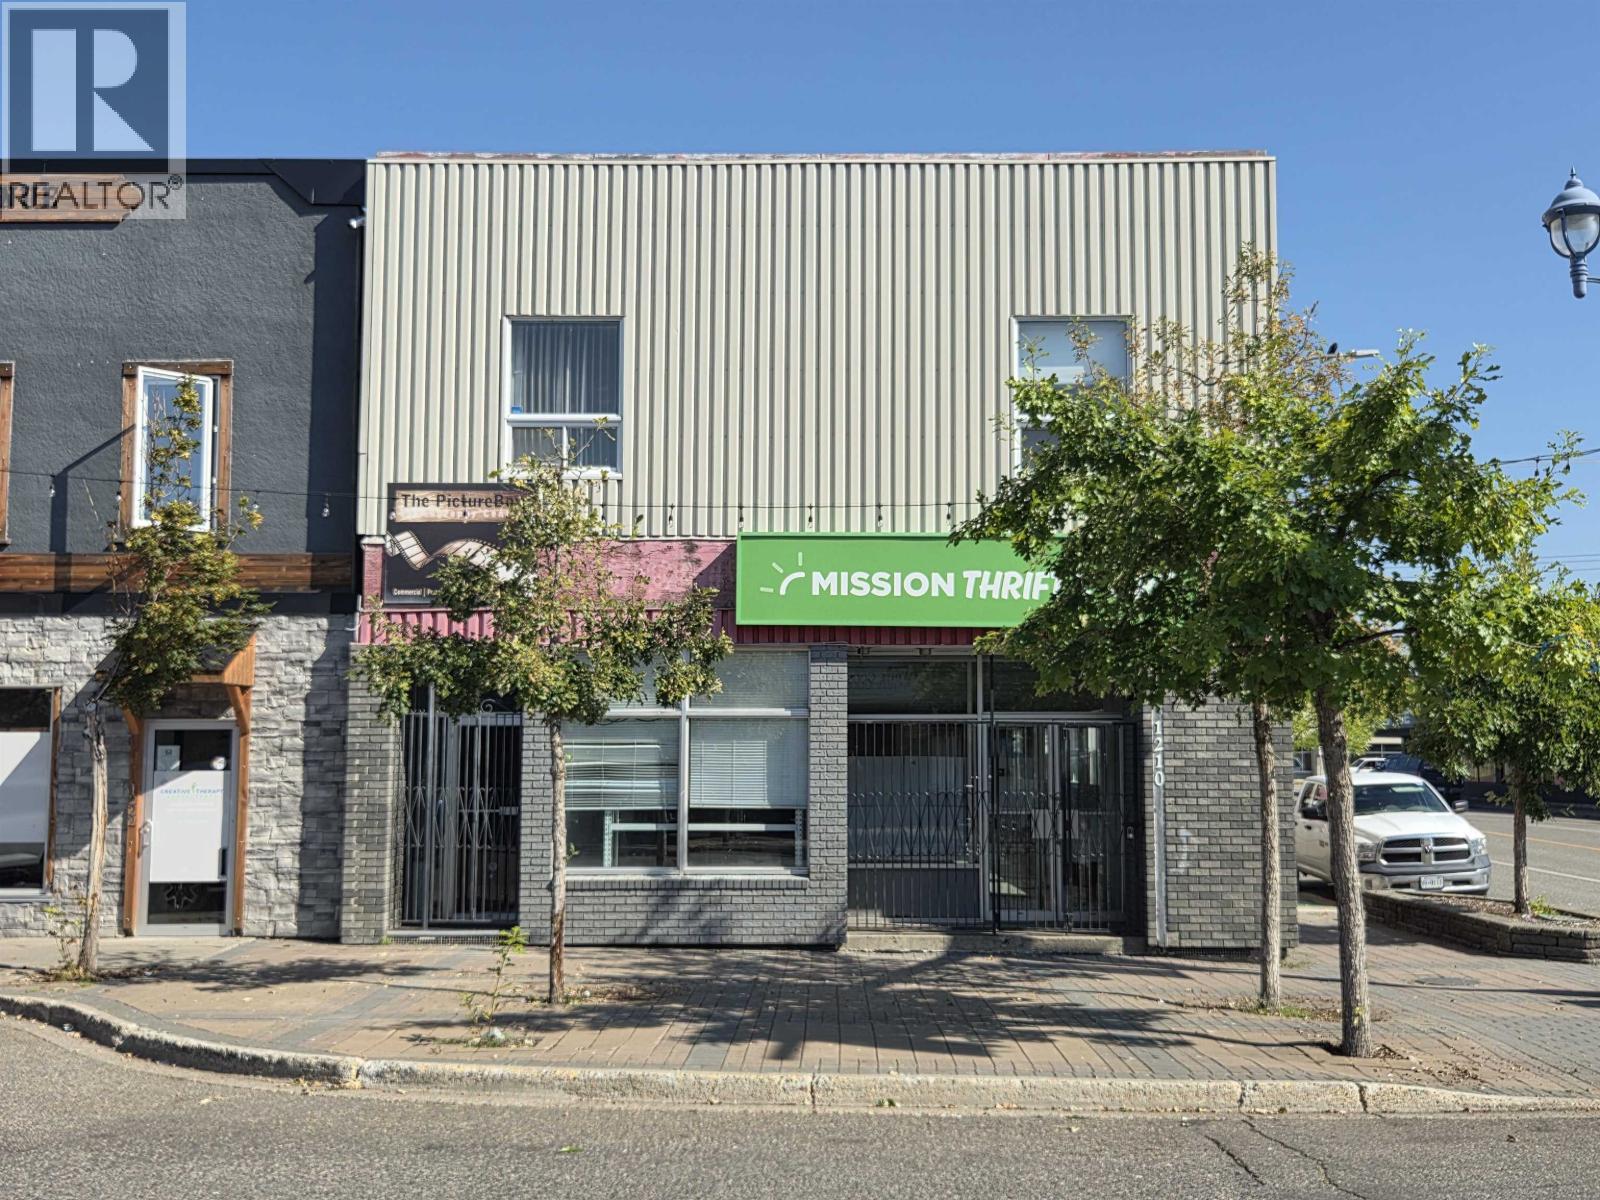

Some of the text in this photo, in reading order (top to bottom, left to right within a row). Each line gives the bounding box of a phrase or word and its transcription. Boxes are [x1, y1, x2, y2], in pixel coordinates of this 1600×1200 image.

[402, 494, 430, 508] The
[393, 588, 422, 596] Commercial
[811, 570, 955, 597] MISSION
[1153, 720, 1165, 787] 1210
